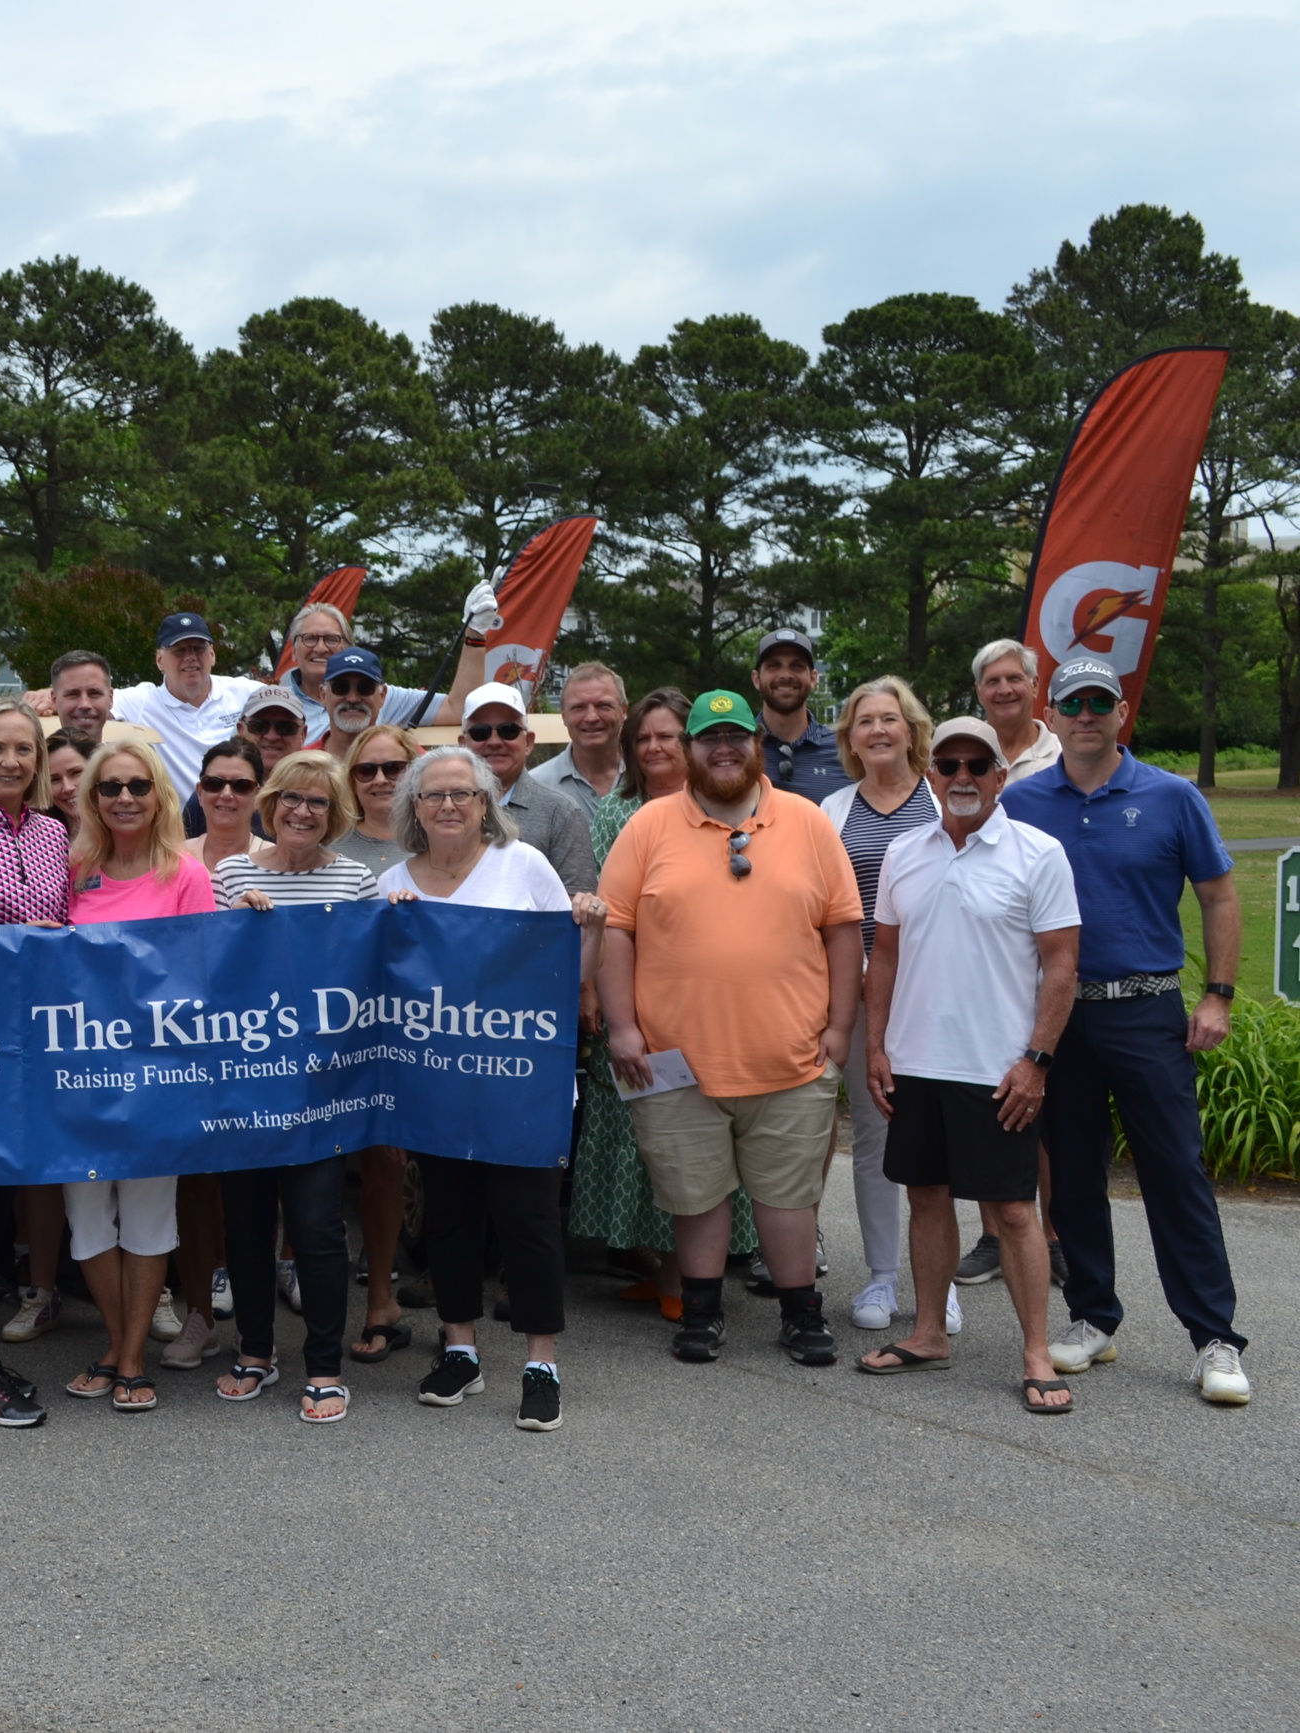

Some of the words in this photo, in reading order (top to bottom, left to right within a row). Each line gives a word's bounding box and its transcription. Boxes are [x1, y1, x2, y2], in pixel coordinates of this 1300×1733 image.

[1039, 561, 1159, 677] G
[1059, 661, 1114, 682] Titleist
[31, 1001, 134, 1053] The
[147, 991, 300, 1053] King's
[312, 985, 558, 1042] Daughters
[55, 1067, 137, 1093] Raising
[142, 1062, 215, 1086] Funds,
[220, 1055, 299, 1081] Friends
[304, 1052, 322, 1075] &
[327, 1044, 418, 1071] Awareness
[423, 1047, 453, 1071] for
[457, 1053, 534, 1078] CHKD
[200, 1092, 396, 1133] www.kingsdaughters.org
